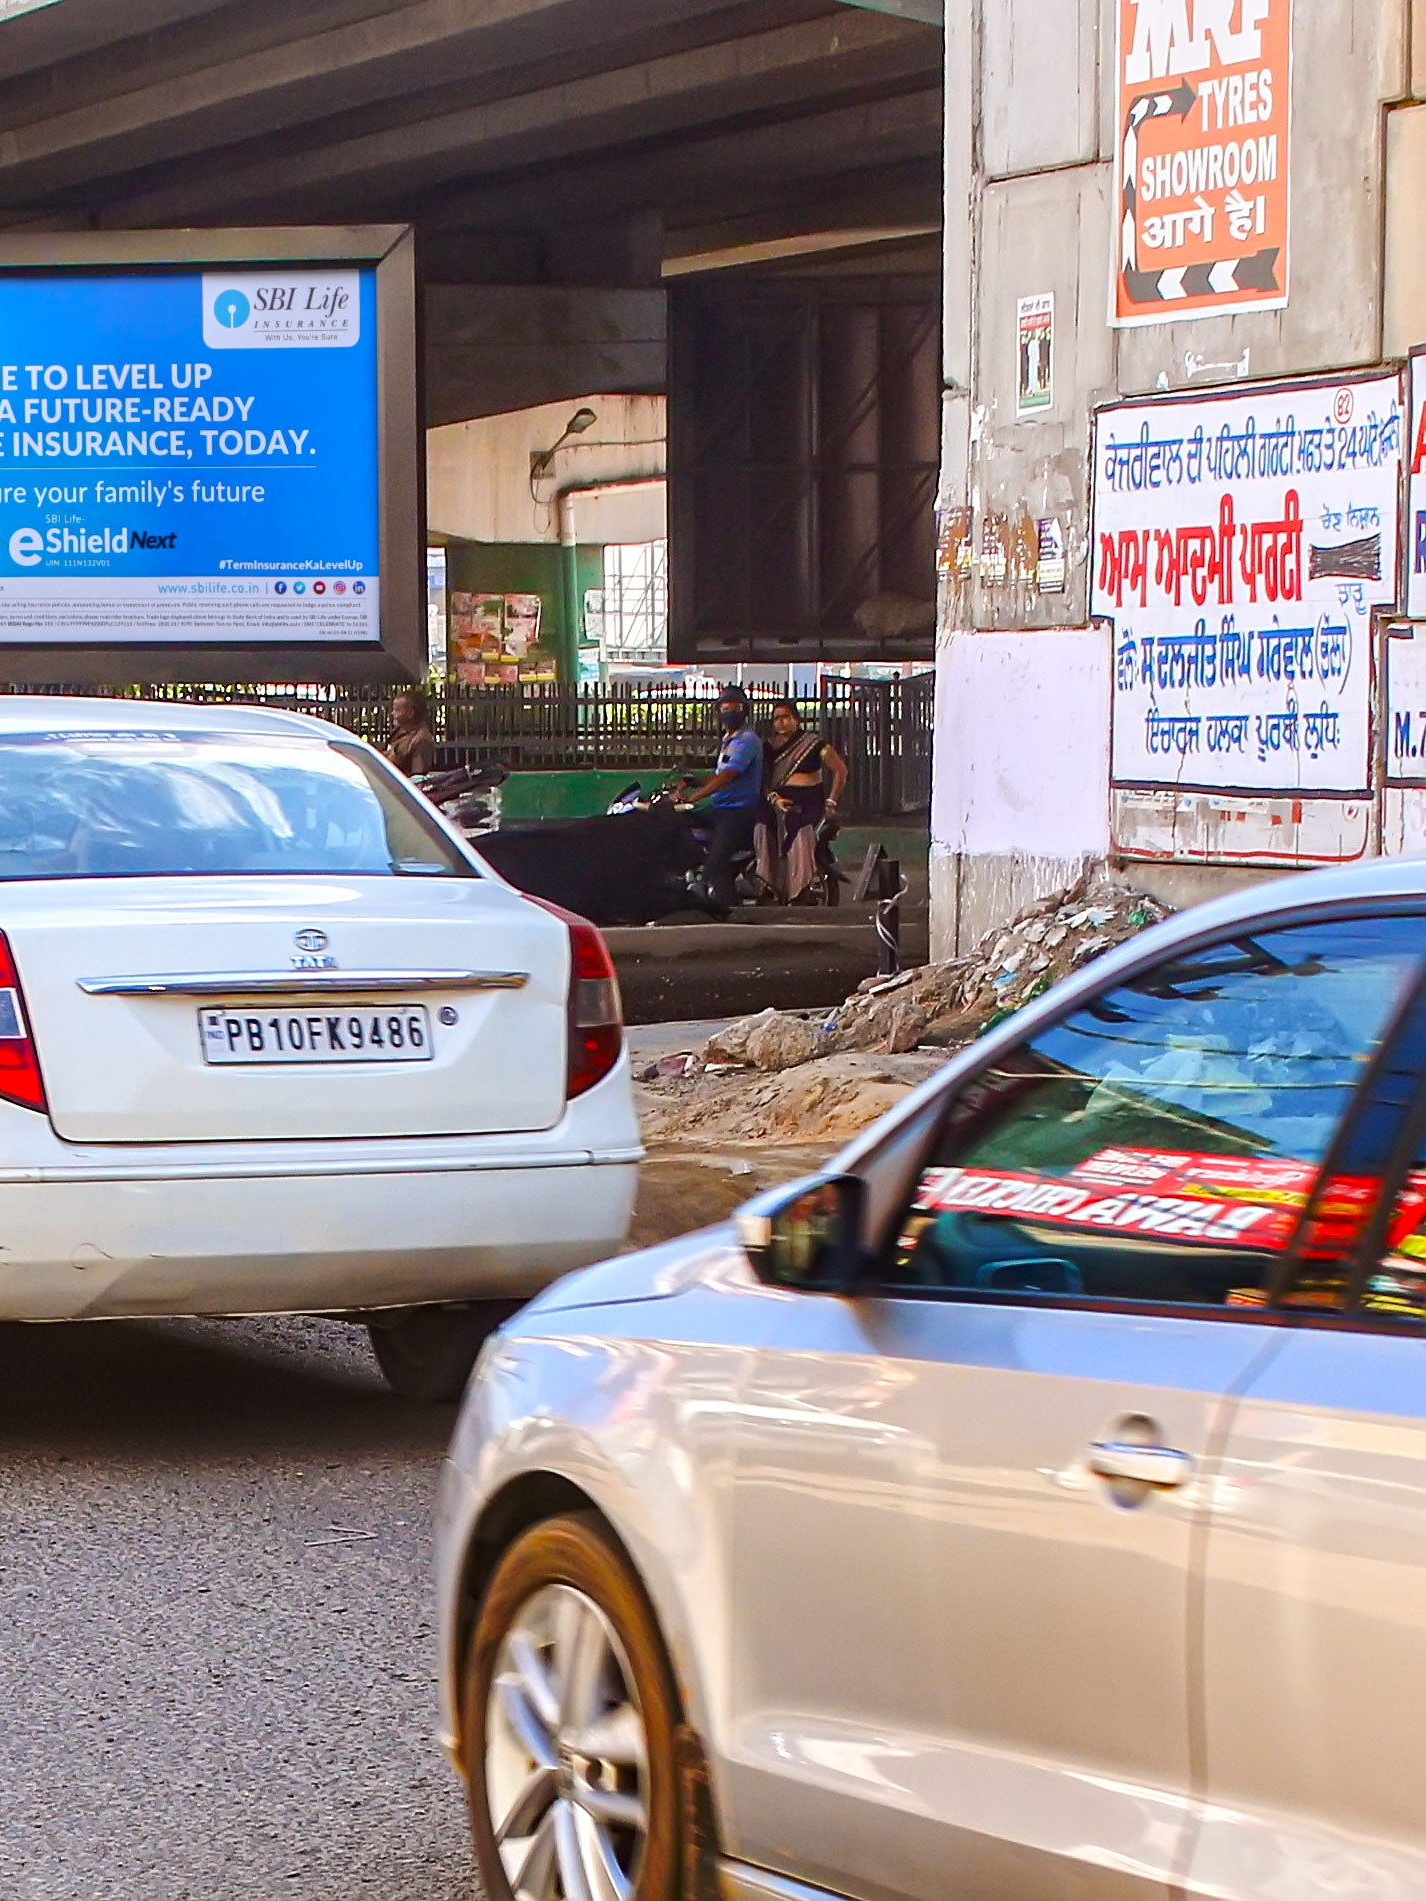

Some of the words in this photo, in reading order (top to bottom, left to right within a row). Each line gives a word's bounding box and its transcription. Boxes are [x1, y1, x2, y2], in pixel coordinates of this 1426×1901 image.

[1125, 0, 1269, 84] MRF
[1198, 68, 1273, 132] TYRES
[1141, 134, 1278, 202] SHOWROOM
[1141, 195, 1216, 249] आगे
[253, 287, 298, 311] SBI
[303, 286, 349, 318] Life
[254, 319, 349, 329] INSURANCE
[297, 333, 319, 341] You're
[321, 333, 338, 341] Sure
[25, 365, 68, 390] TO
[76, 364, 163, 390] LEVEL
[171, 363, 212, 389] UP
[24, 396, 255, 423] FUTURE-READY
[1337, 393, 1351, 417] 82
[13, 430, 193, 460] INSURANCE,
[199, 429, 316, 455] TODAY.
[1105, 421, 1183, 492] ਕੇਜਰੀਵਾਲ
[1187, 425, 1203, 484] ਦੀ
[1206, 415, 1256, 482] ਪਹਿਲੀ
[1337, 427, 1357, 471] 24
[34, 486, 88, 507] your
[94, 480, 184, 507] family's
[191, 480, 265, 503] future
[46, 515, 61, 524] SBI
[130, 530, 177, 549] Next
[1099, 530, 1149, 608] ਆਮ
[1154, 493, 1235, 607] ਆਦਮੀ
[1239, 488, 1303, 603] ਪਾਰਟੀ
[219, 559, 364, 571] #TermInsuranceKaLevelUp
[158, 582, 259, 594] www.sbilife.co.in
[1157, 619, 1217, 689] ਦਲਜੀਤ
[1219, 613, 1254, 688] ਸਿੰਘ
[1257, 614, 1314, 682] ਗਰੇਵਾਲ
[290, 955, 338, 969] TATA
[225, 1016, 424, 1052] PB10FK9486
